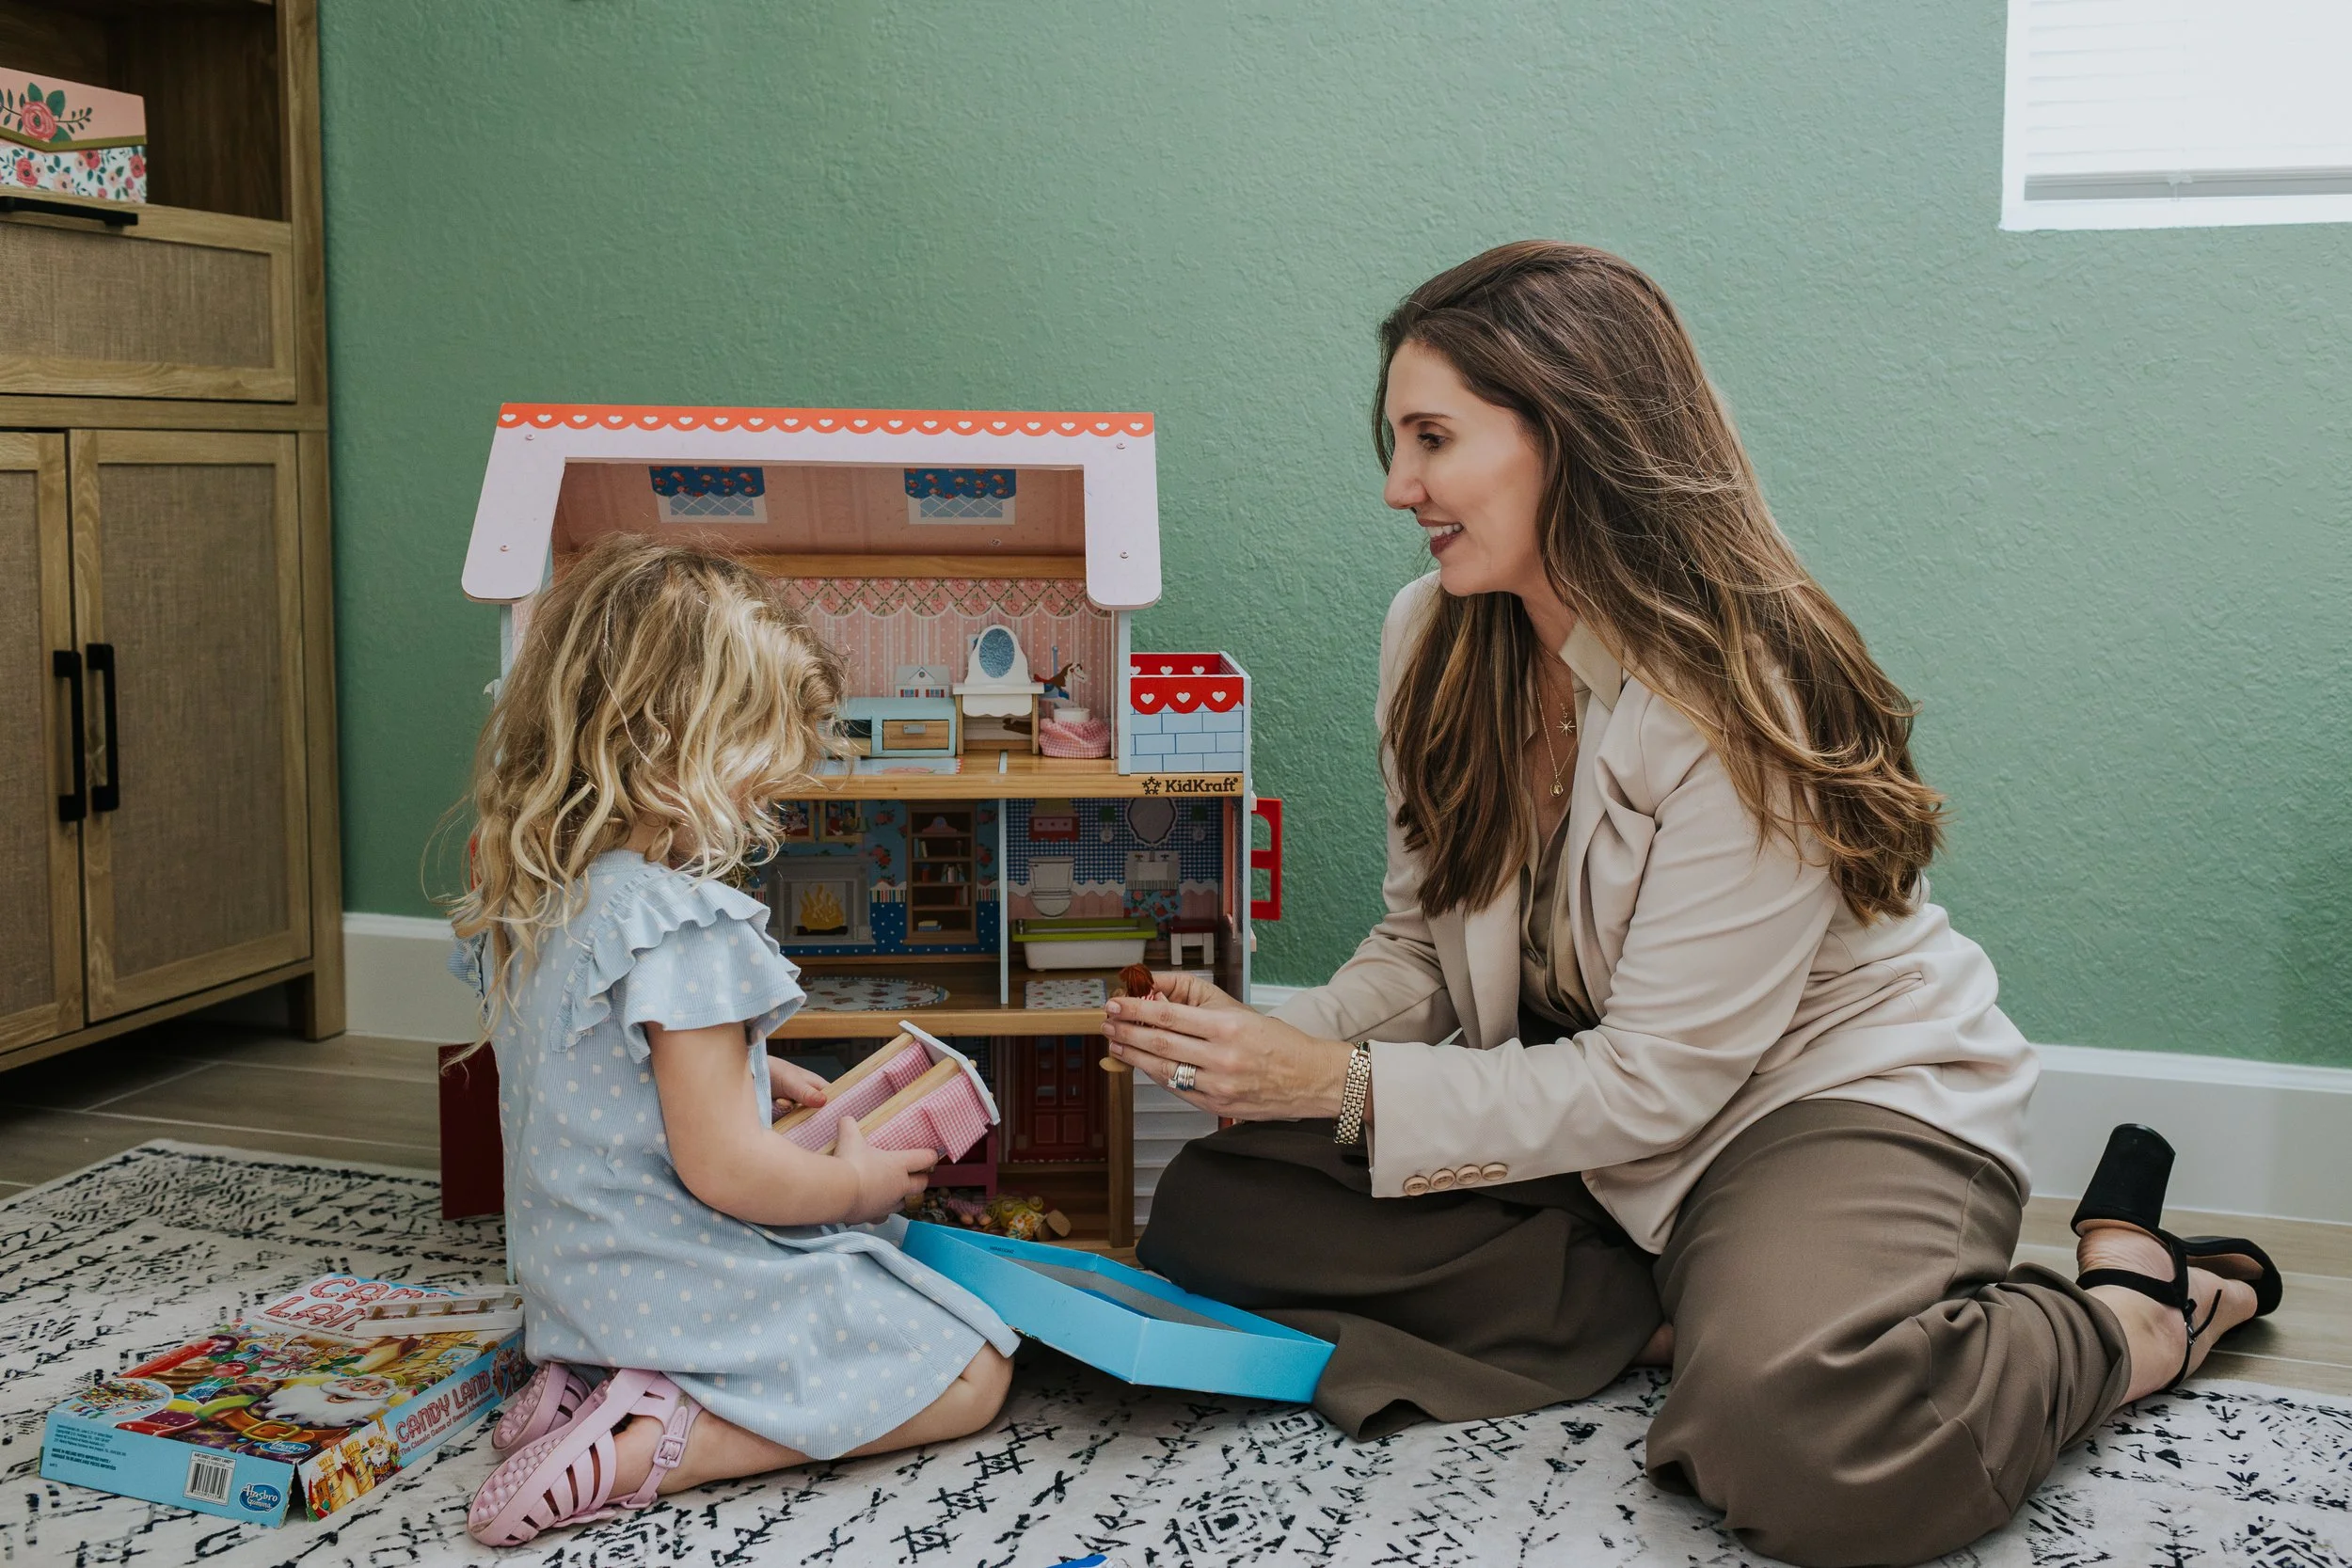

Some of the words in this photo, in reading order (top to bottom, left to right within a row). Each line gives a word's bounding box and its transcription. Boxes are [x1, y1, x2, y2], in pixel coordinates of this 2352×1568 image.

[263, 1295, 367, 1332] LAN
[396, 1394, 450, 1443] CANDY
[452, 1370, 490, 1410] LAND
[241, 1484, 278, 1502] Hasbro
